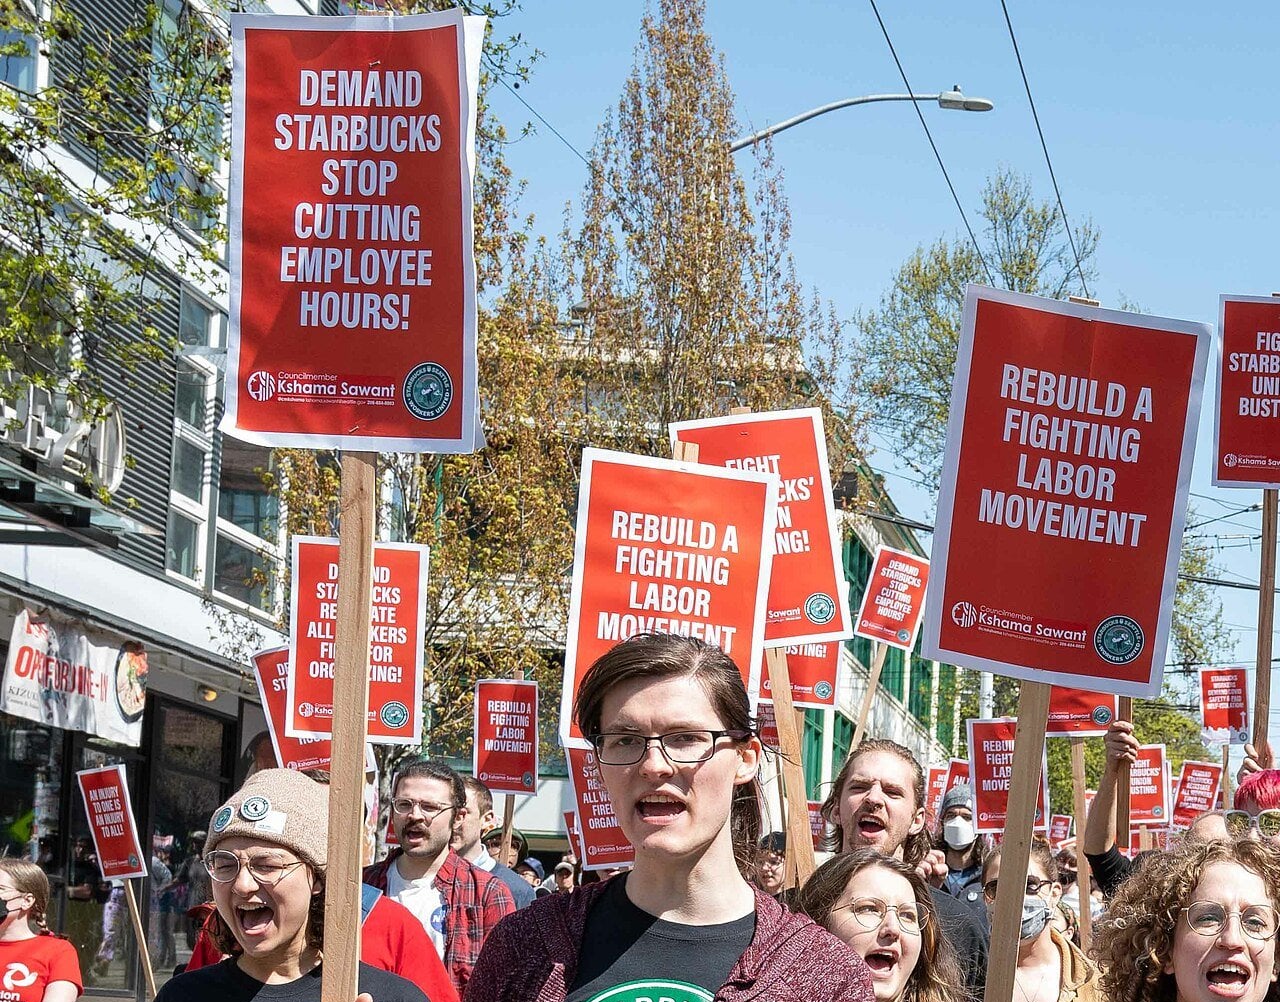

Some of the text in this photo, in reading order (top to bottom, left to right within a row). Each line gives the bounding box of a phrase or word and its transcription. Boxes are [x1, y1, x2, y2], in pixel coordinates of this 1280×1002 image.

[299, 69, 422, 108] DEMAND
[274, 113, 441, 153] STARBUCKS
[321, 158, 398, 197] STOP
[294, 202, 420, 242] CUTTING
[280, 246, 432, 286] EMPLOYEE
[300, 291, 410, 330] HOURS!
[278, 371, 338, 381] Councilmember
[278, 380, 395, 398] Kshama Sawant
[1000, 363, 1153, 423] REBUILD A
[1003, 407, 1141, 463] FIGHTING
[1238, 457, 1268, 467] Kshama
[1016, 453, 1116, 502] LABOR
[978, 488, 1147, 547] MOVEMENT
[612, 510, 716, 552] REBUILD
[722, 524, 738, 554] A
[616, 546, 729, 585] FIGHTING
[628, 582, 710, 618] LABOR
[979, 604, 1034, 622] Councilmember
[307, 622, 336, 640] ALL
[978, 612, 1032, 634] Kshama
[1036, 623, 1087, 642] Sawant
[488, 700, 532, 714] REBUILD A
[490, 714, 530, 726] FIGHTING
[496, 727, 525, 740] LABOR
[484, 740, 532, 754] MOVEMENT
[993, 766, 1012, 778] LAB
[89, 786, 119, 801] AN INJURY
[982, 780, 1010, 791] MOVE
[92, 799, 122, 813] TO ONE IS
[584, 793, 598, 804] ALL
[96, 810, 124, 826] AN INJURY
[102, 824, 124, 838] TO ALL!
